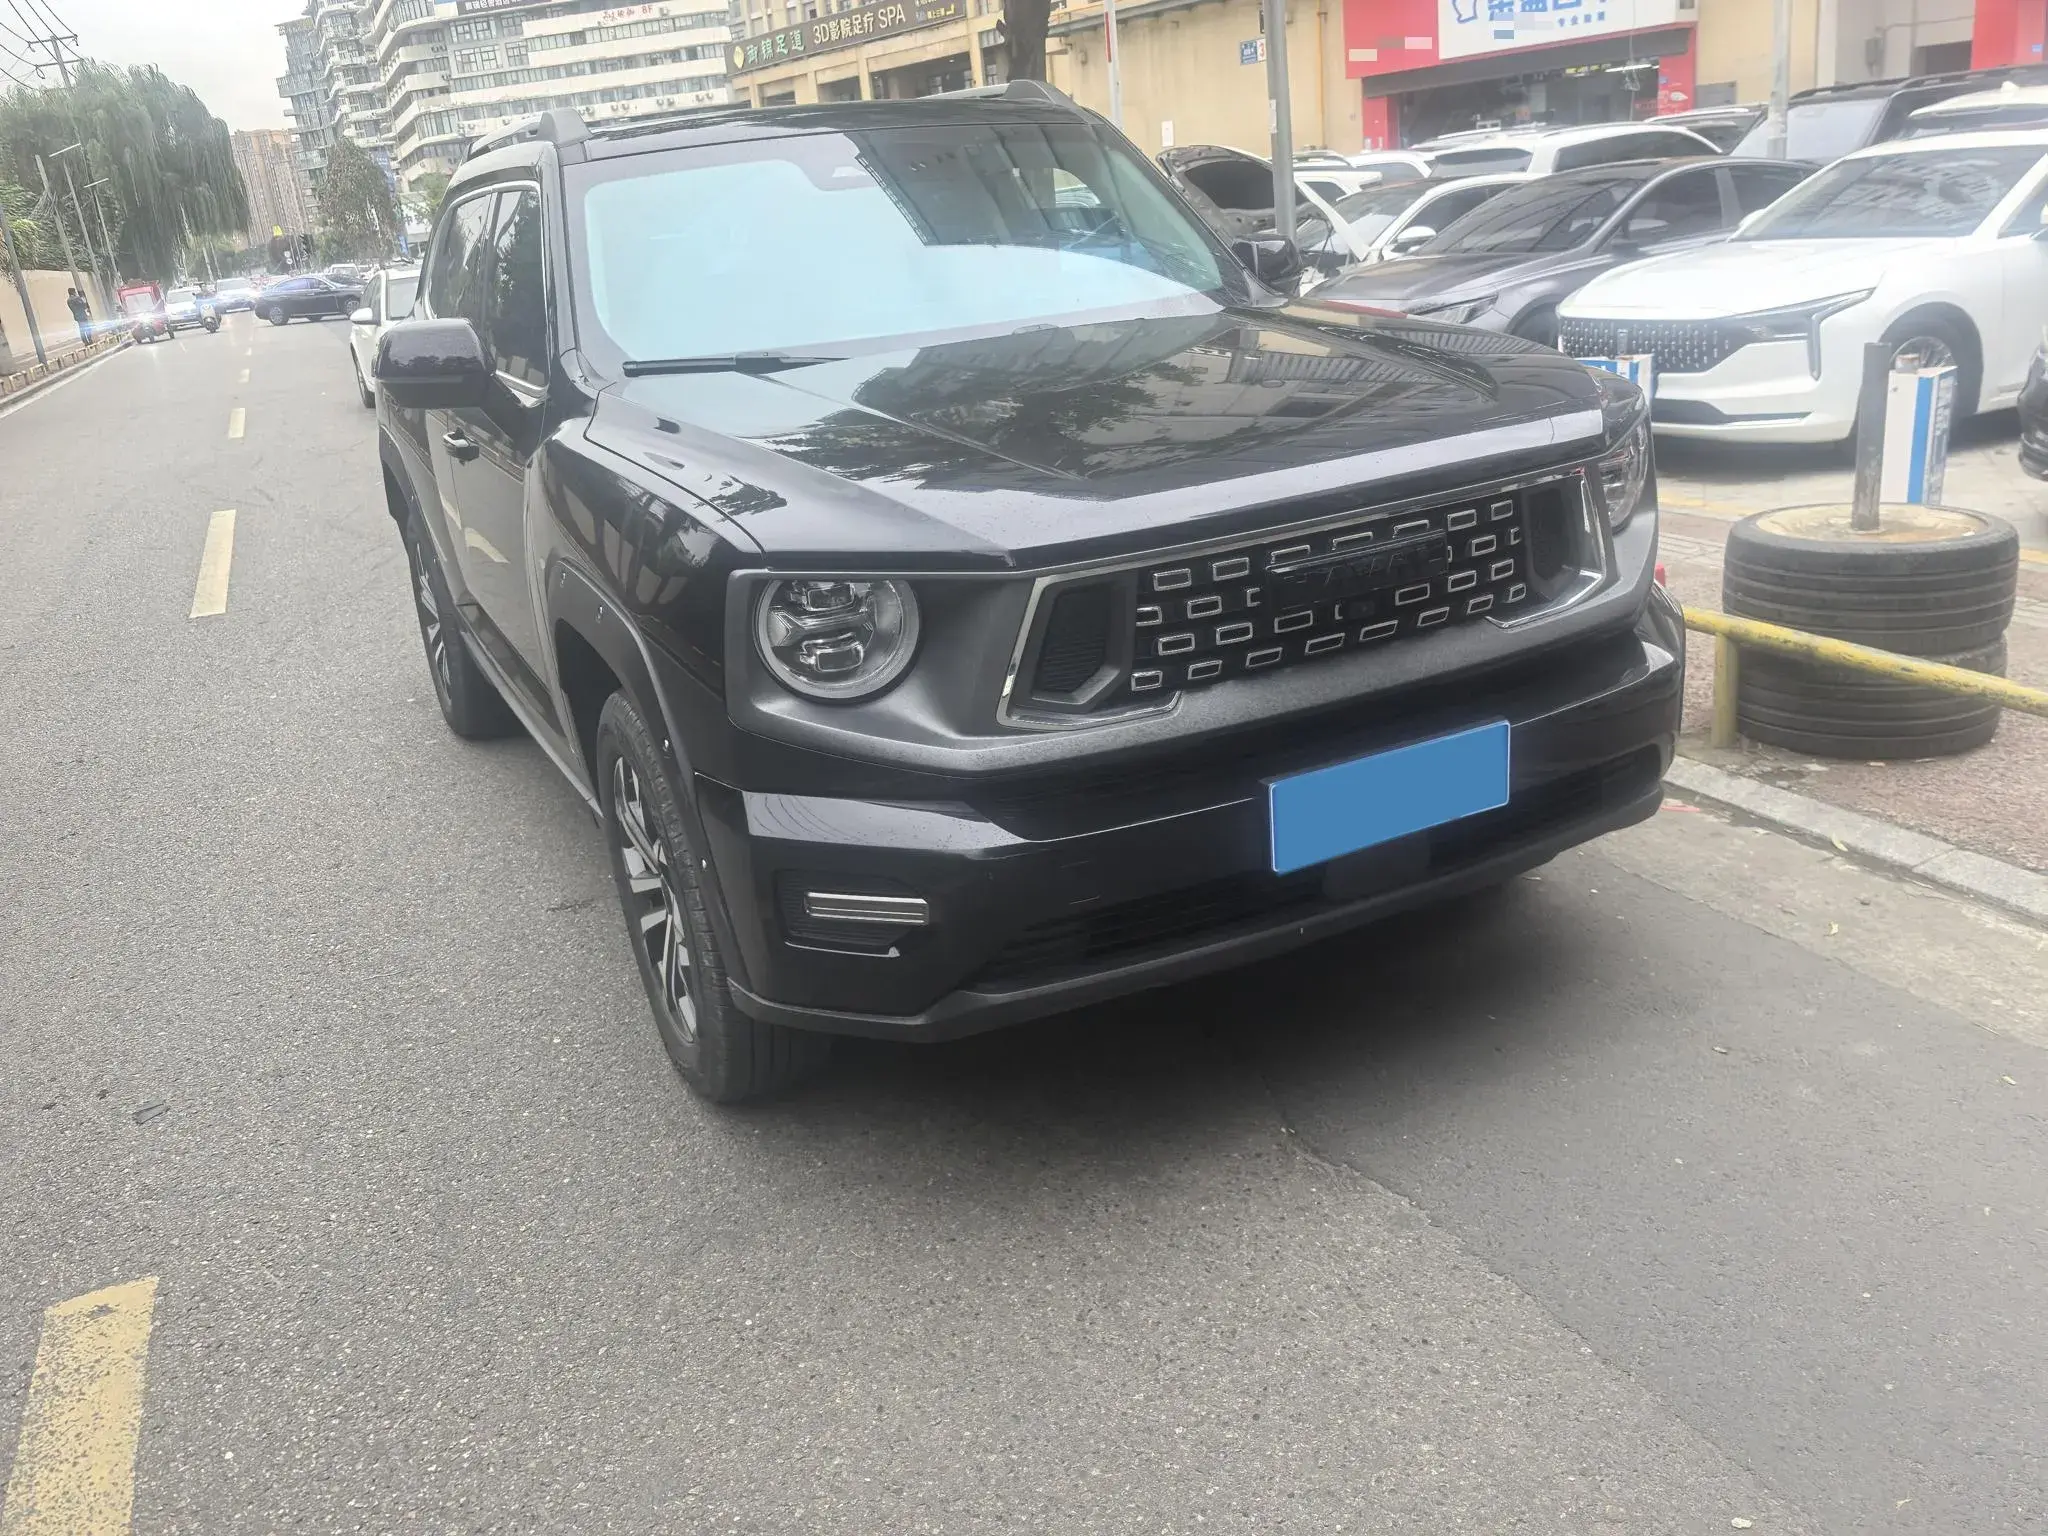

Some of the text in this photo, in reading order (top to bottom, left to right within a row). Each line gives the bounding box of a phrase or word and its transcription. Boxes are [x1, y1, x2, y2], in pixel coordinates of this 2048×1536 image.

[813, 12, 874, 45] 3D影院足疗
[878, 3, 906, 29] SPA
